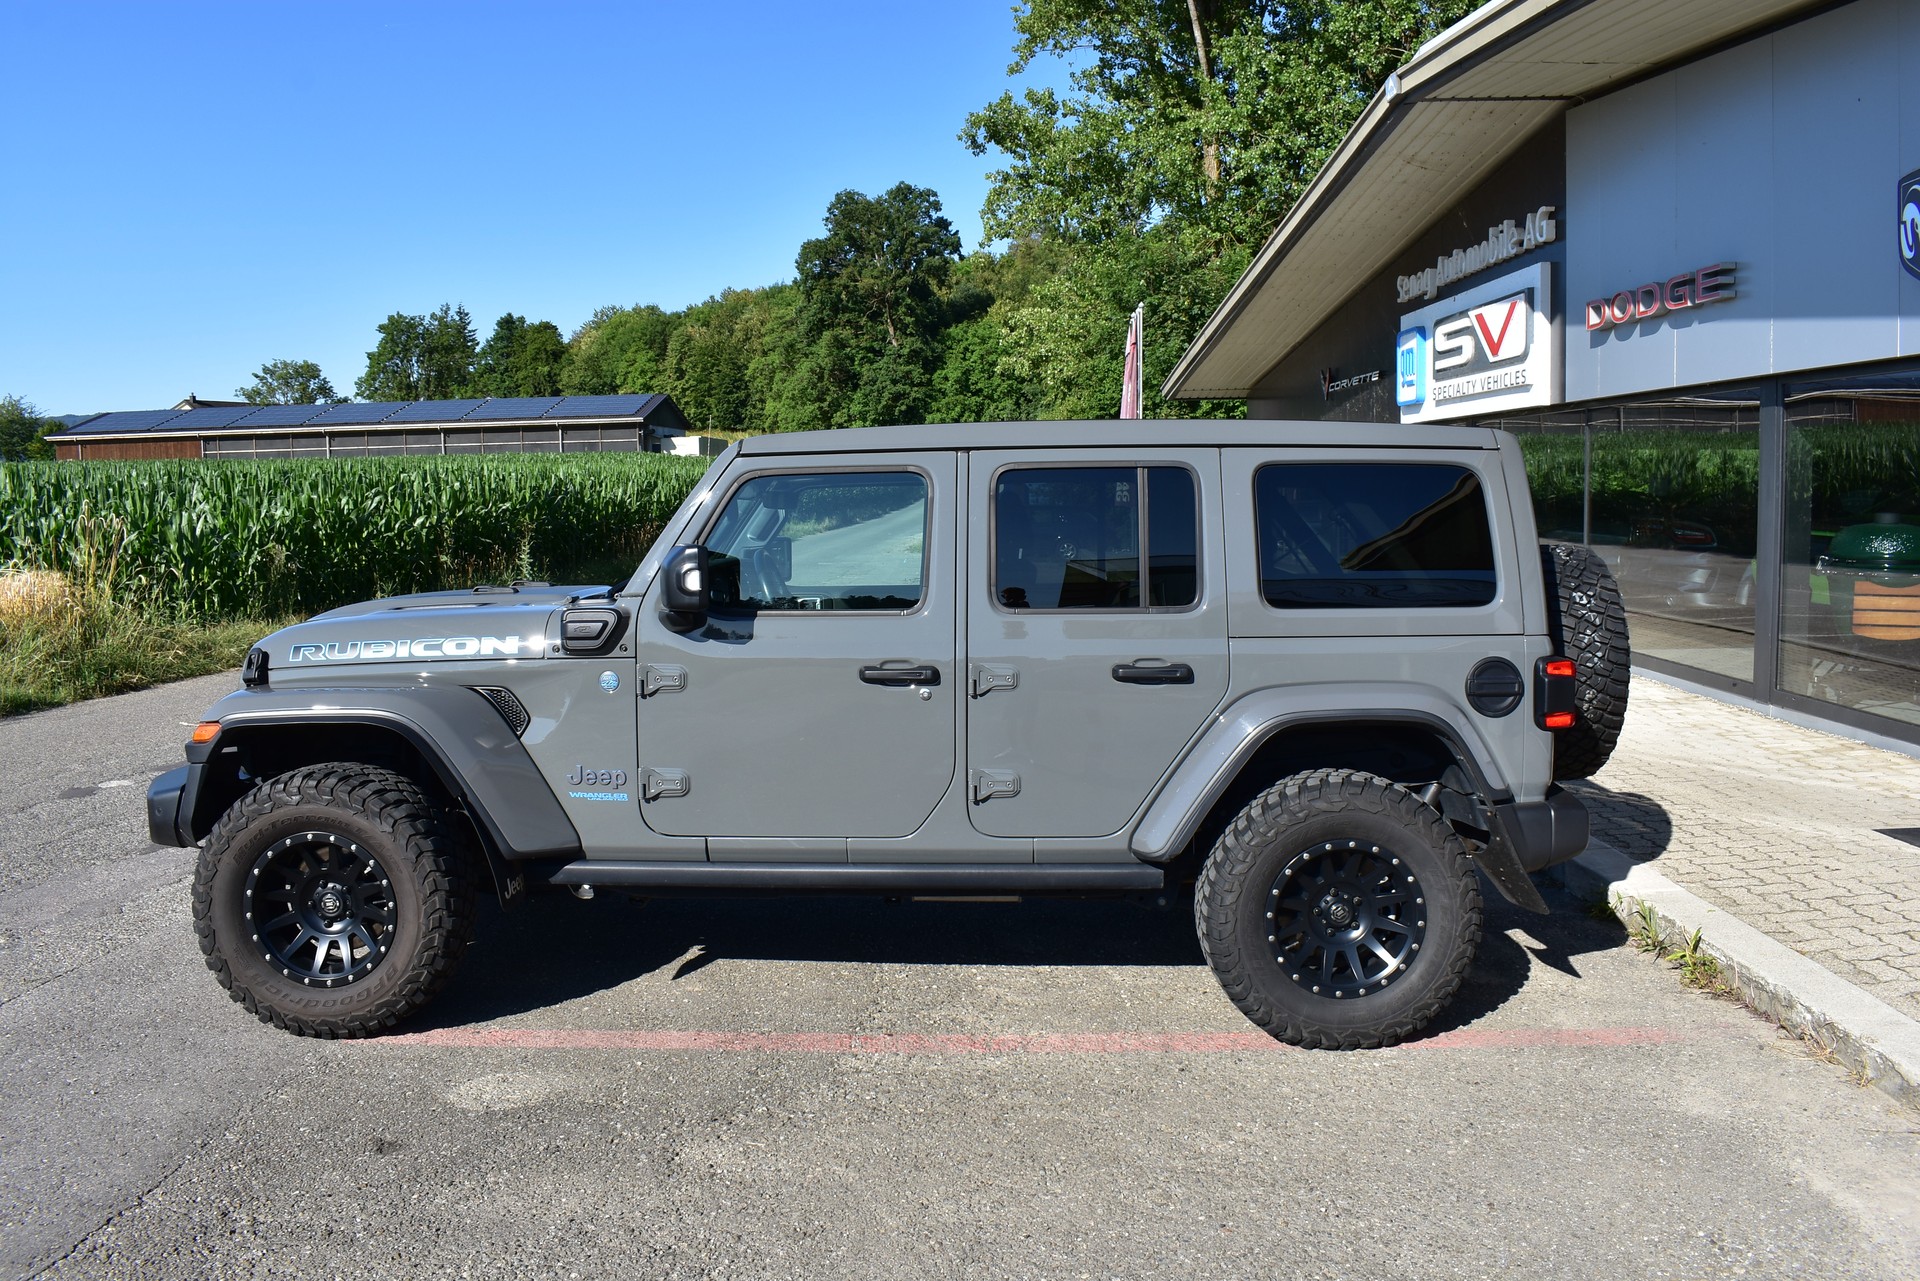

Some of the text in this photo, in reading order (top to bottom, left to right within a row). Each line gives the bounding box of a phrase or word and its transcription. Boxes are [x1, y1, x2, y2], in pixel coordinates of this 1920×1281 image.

[1397, 206, 1556, 303] Senag Automobile AG
[1585, 260, 1737, 331] DODGE
[1434, 298, 1520, 371] SV
[1328, 370, 1380, 392] CORVETTE
[1432, 368, 1527, 401] SPECIALTY VEHICLES
[288, 636, 520, 662] RUBICON
[566, 764, 628, 790] Jeep
[568, 791, 628, 800] WRANGLER
